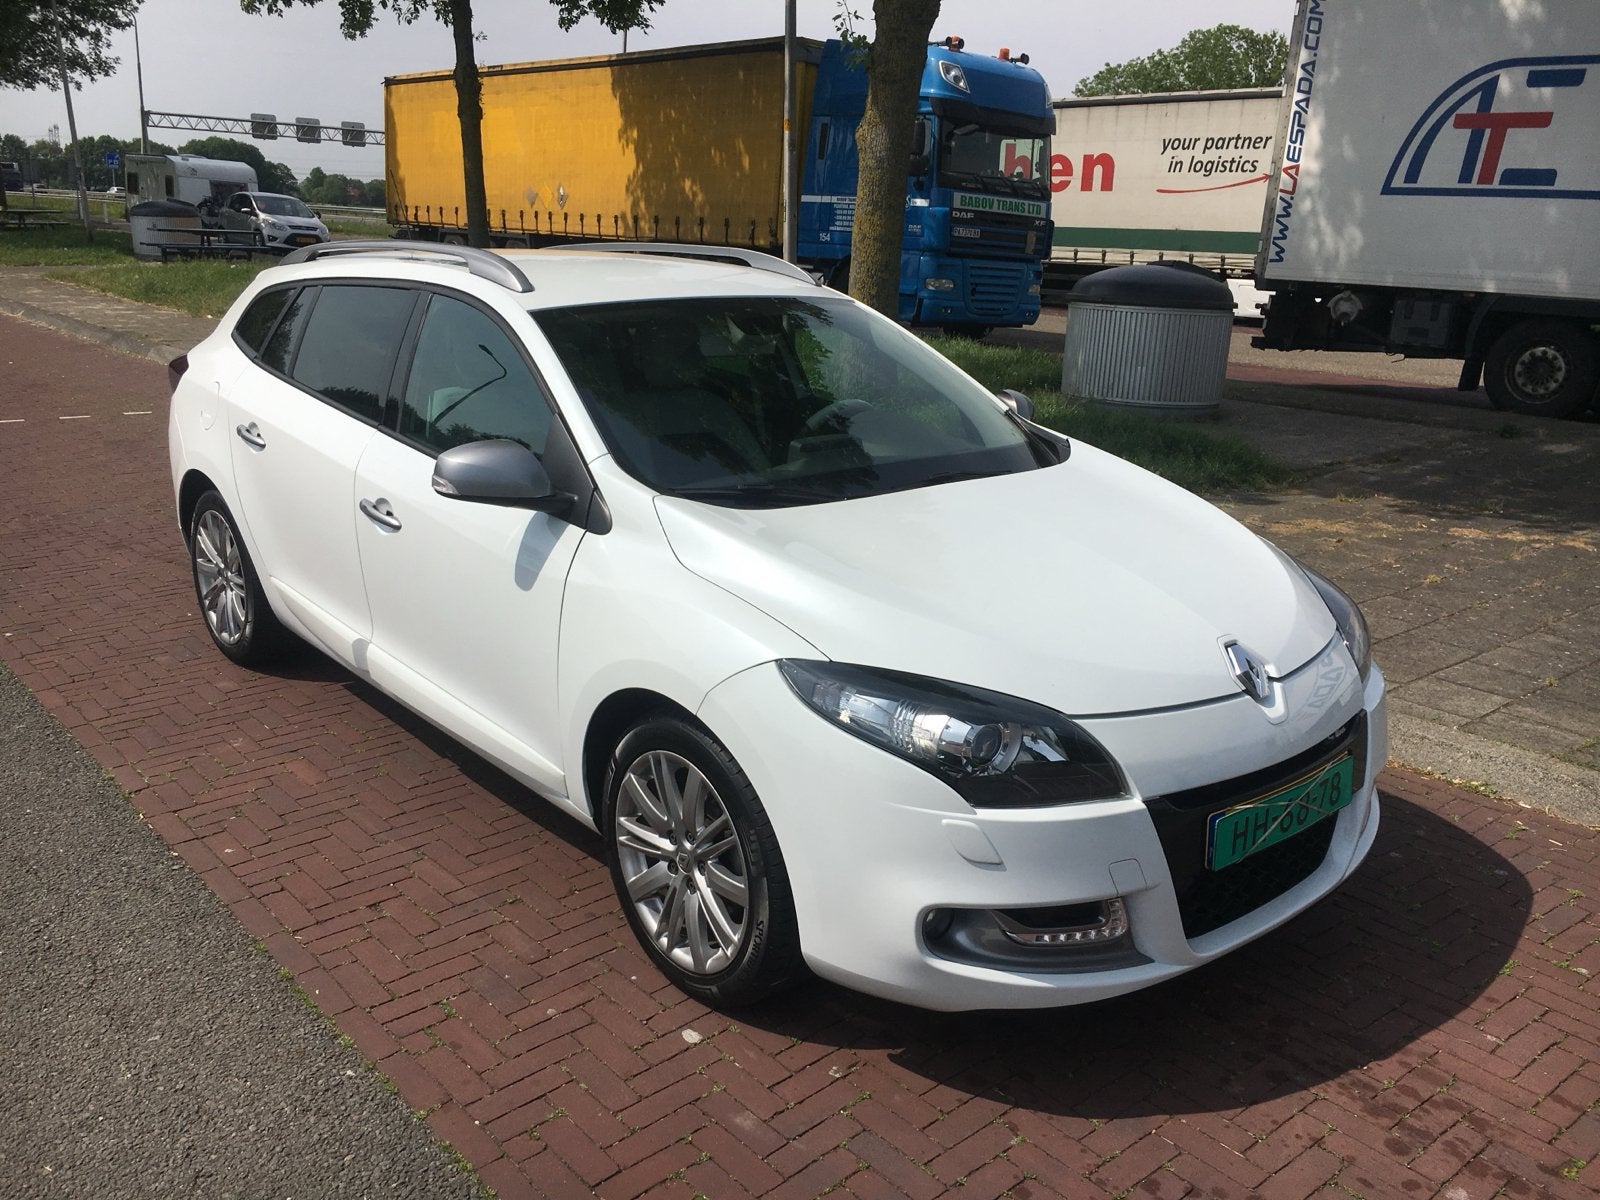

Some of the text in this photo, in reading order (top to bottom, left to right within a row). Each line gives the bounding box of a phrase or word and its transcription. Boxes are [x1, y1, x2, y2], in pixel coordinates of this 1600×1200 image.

[1160, 133, 1273, 155] your partner
[1167, 155, 1259, 177] in logistics
[952, 211, 975, 219] DAF
[960, 195, 1042, 216] BABOV TRANS LTD
